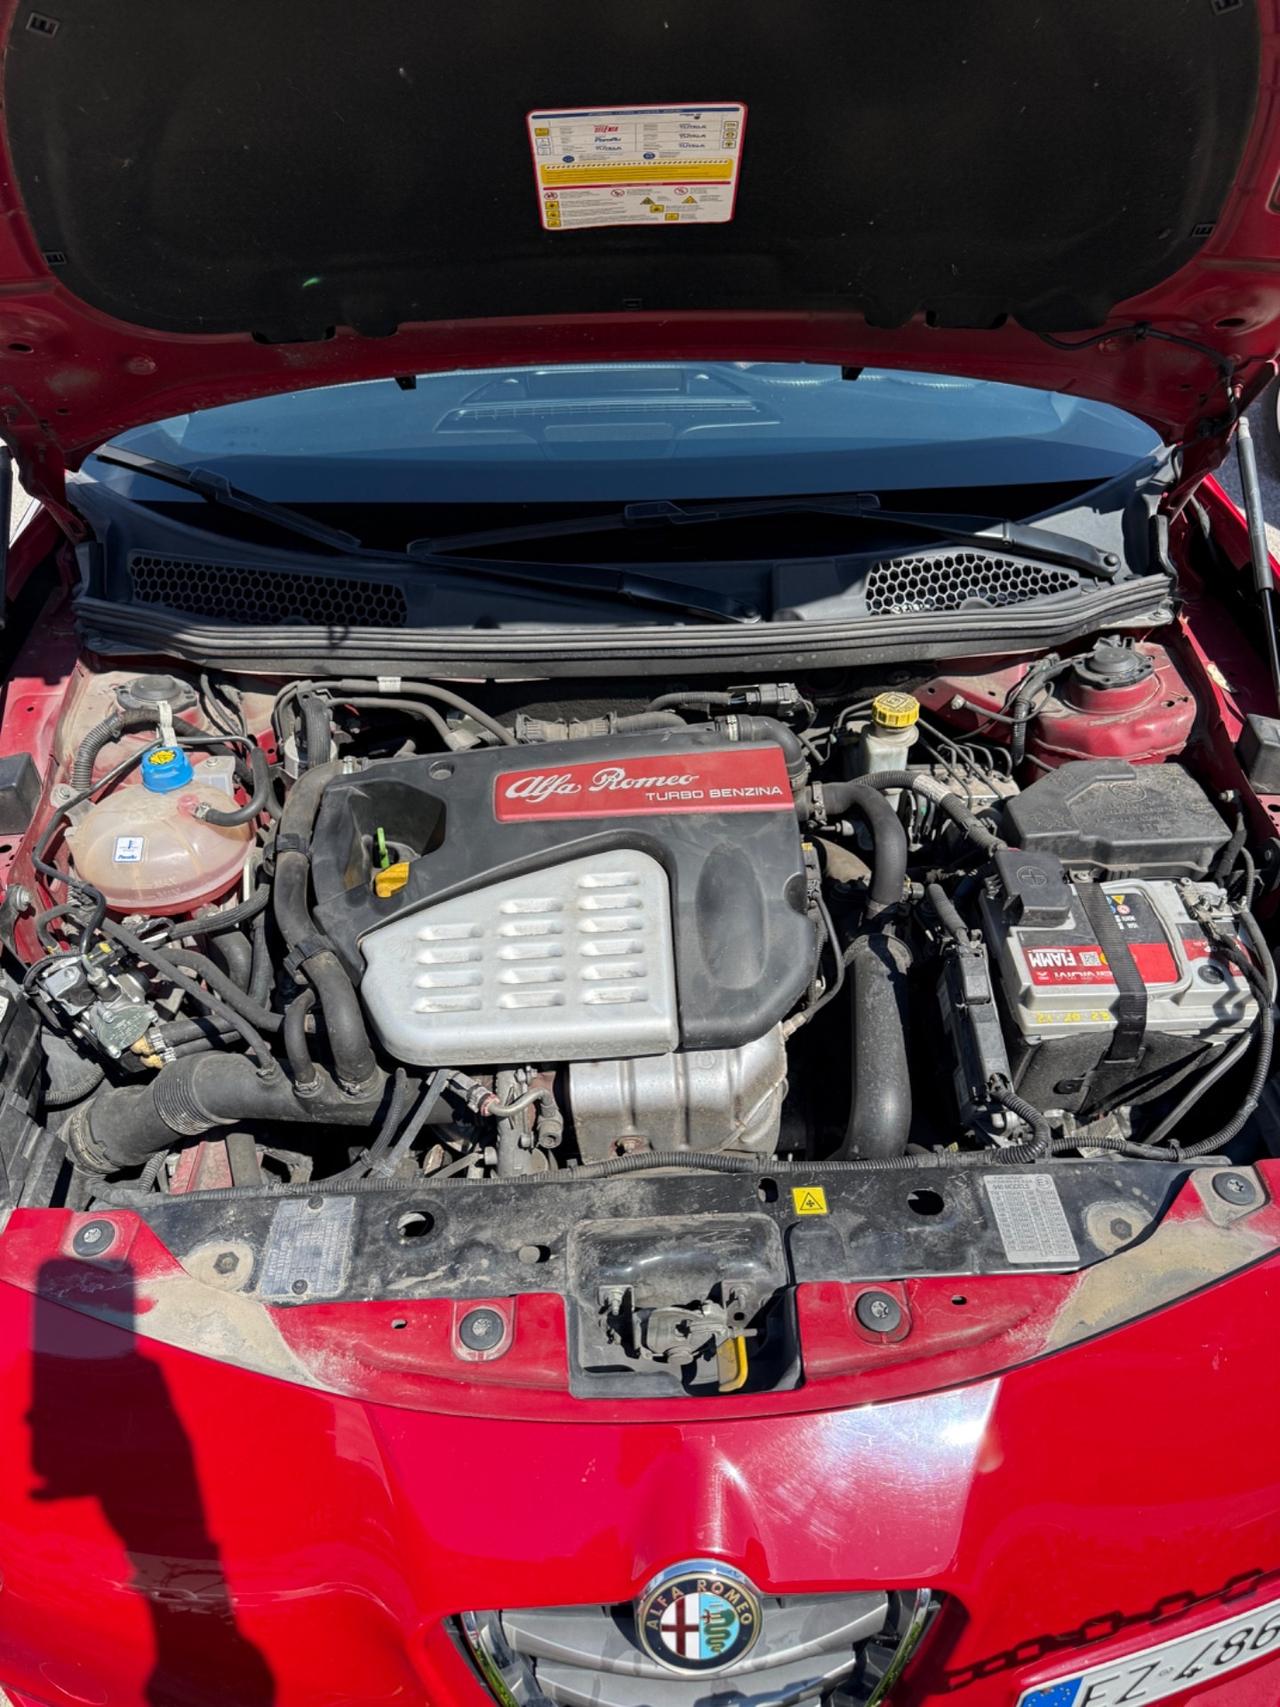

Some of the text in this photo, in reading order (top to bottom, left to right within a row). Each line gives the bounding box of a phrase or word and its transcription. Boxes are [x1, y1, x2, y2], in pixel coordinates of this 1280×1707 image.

[505, 767, 700, 803] Alfa Romeo
[645, 785, 784, 802] TURBO BENZINA
[1028, 951, 1078, 968] FIAMM
[647, 1579, 753, 1631] ALFA ROMEO
[1172, 1612, 1280, 1682] 486
